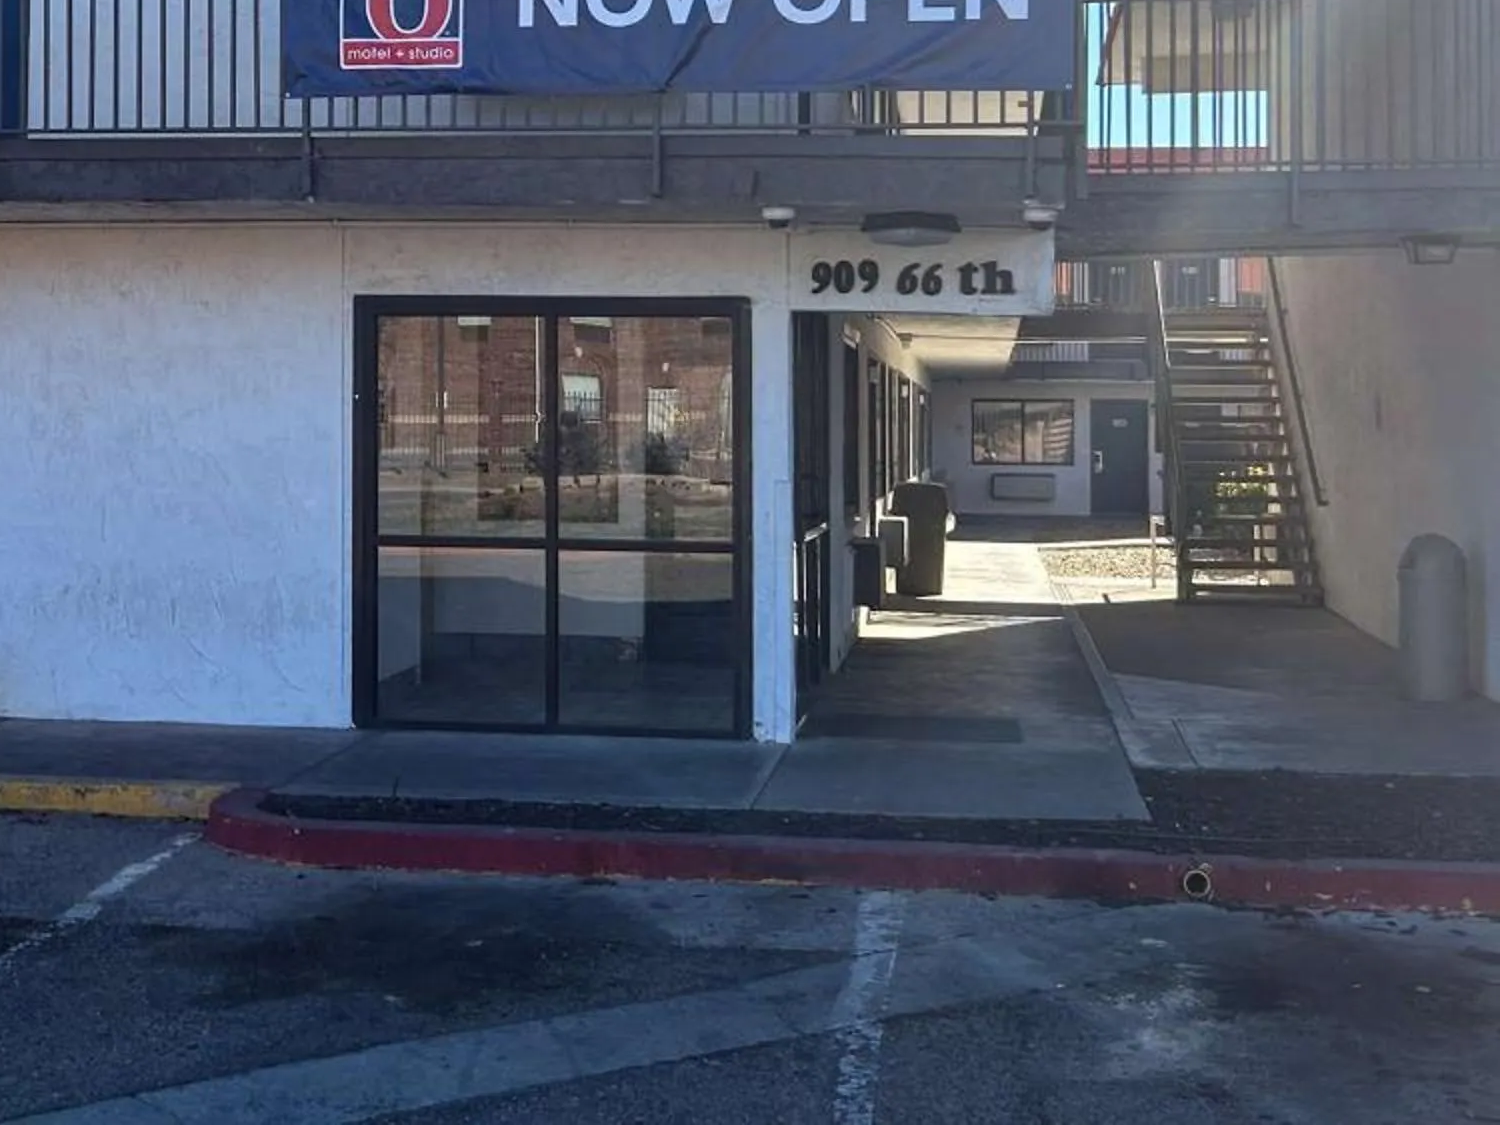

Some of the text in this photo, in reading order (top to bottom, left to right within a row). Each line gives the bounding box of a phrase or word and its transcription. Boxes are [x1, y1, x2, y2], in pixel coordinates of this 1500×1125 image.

[347, 46, 392, 60] motel
[408, 46, 454, 60] studio
[811, 258, 1017, 296] 909 66 th
